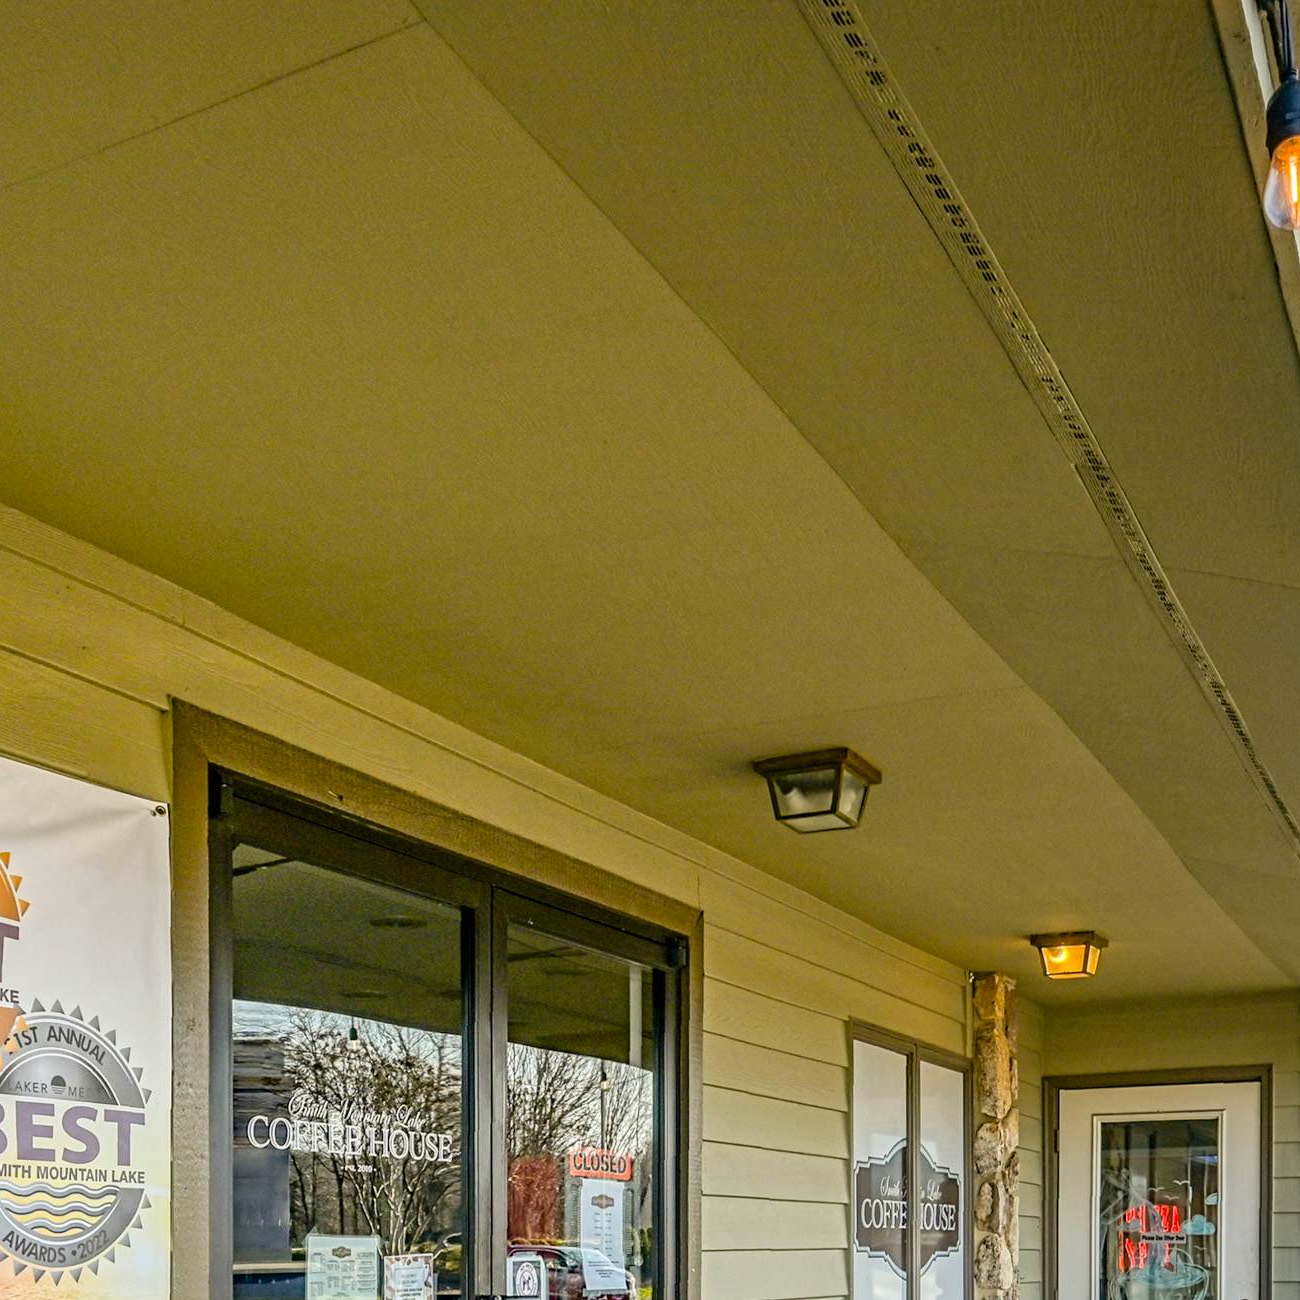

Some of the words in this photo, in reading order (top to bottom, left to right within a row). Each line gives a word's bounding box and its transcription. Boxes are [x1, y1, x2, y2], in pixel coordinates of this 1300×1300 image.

[4, 1027, 37, 1055] 1ST
[47, 1026, 106, 1065] ANNUAL
[396, 1104, 428, 1128] Lake
[247, 1115, 364, 1156] COFFEE
[368, 1128, 453, 1162] HOUSE
[36, 1166, 106, 1182] MOUNTAIN
[111, 1168, 145, 1183] LAKE
[573, 1152, 626, 1173] CLOSED
[2, 1230, 65, 1264] AWARDS
